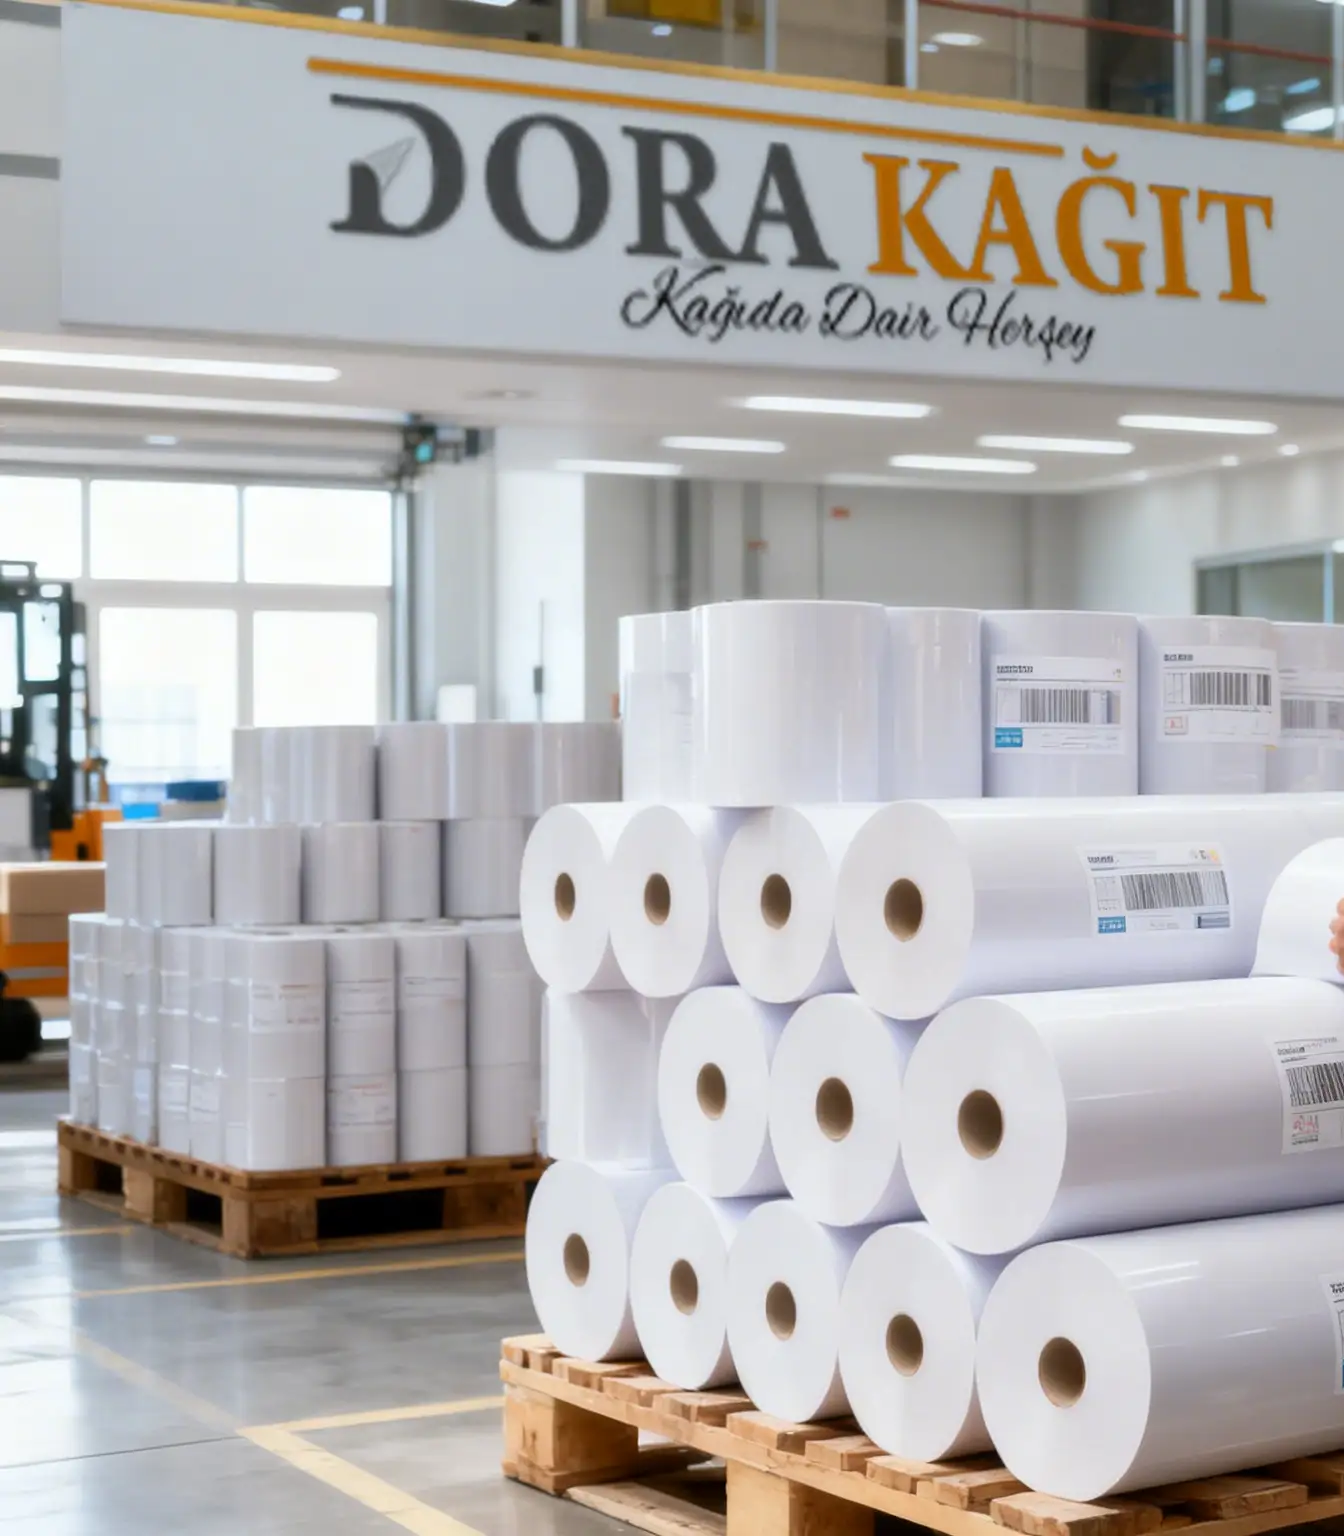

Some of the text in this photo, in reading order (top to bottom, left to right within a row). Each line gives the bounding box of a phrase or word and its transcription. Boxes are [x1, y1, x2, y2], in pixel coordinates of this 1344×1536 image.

[330, 93, 1274, 303] DORA KAĞIT
[620, 265, 1096, 363] Kağıda Dair Herşey
